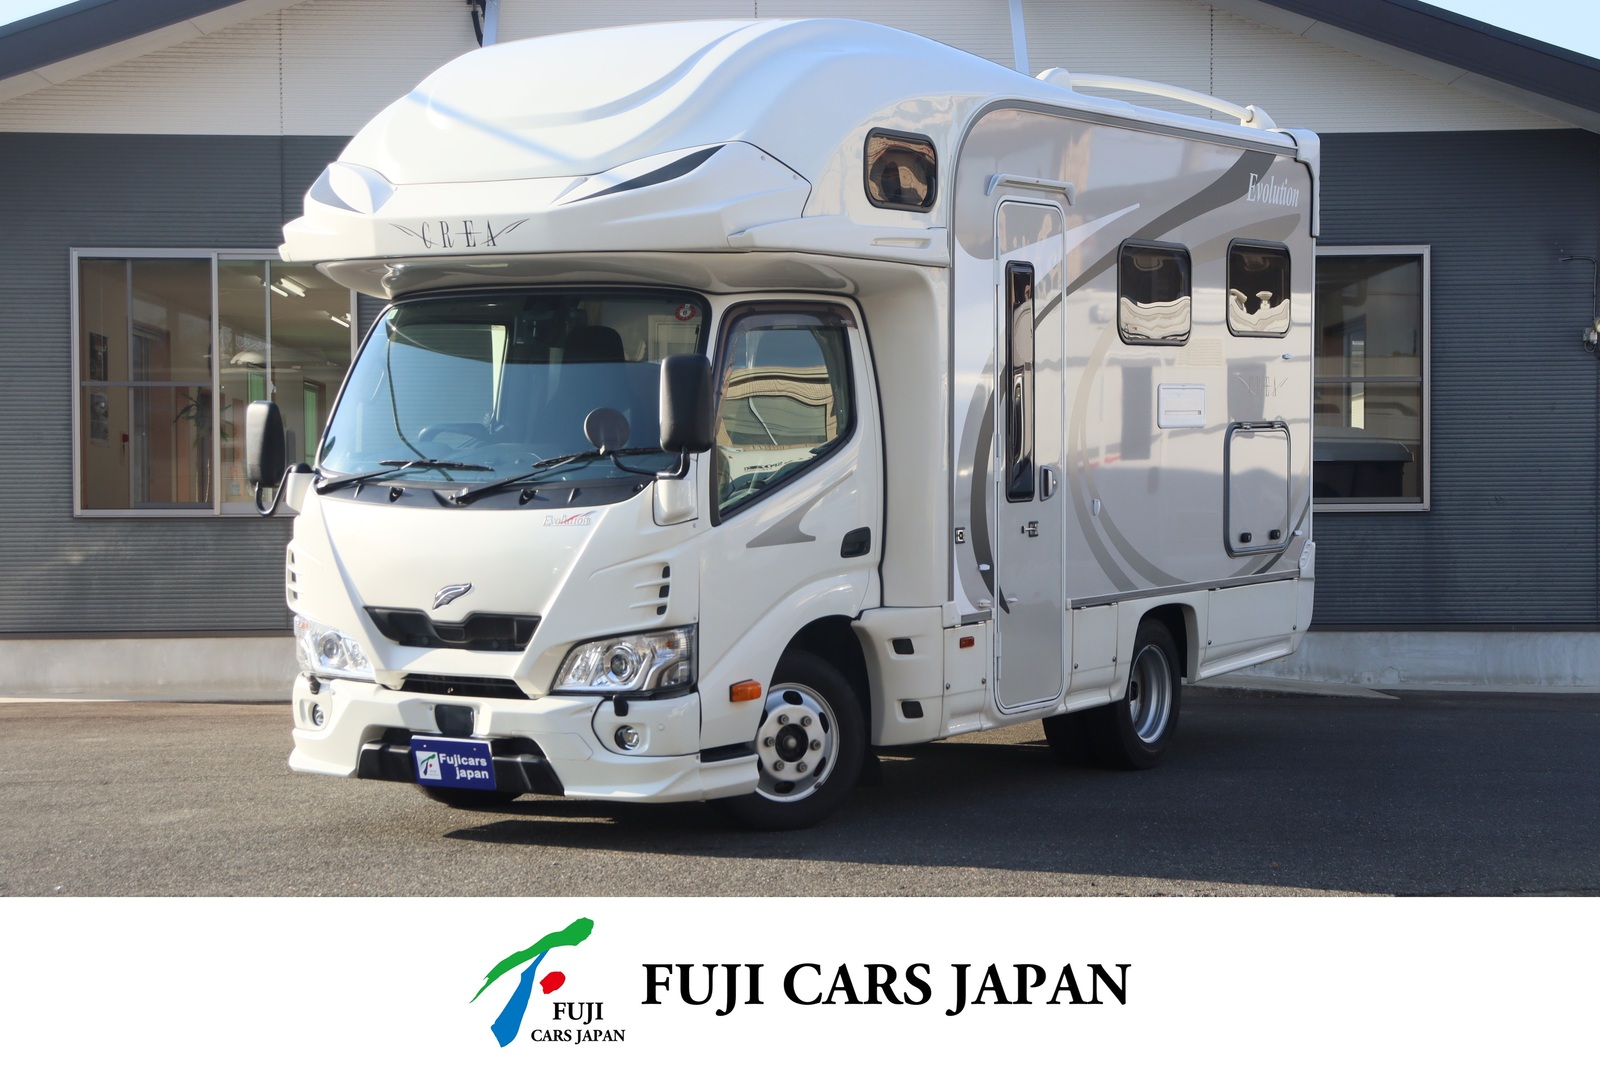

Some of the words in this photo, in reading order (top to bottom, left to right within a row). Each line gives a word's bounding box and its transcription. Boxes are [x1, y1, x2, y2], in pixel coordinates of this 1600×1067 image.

[1247, 172, 1299, 207] Evolution
[420, 219, 498, 249] CREA
[439, 753, 487, 767] Fujicars
